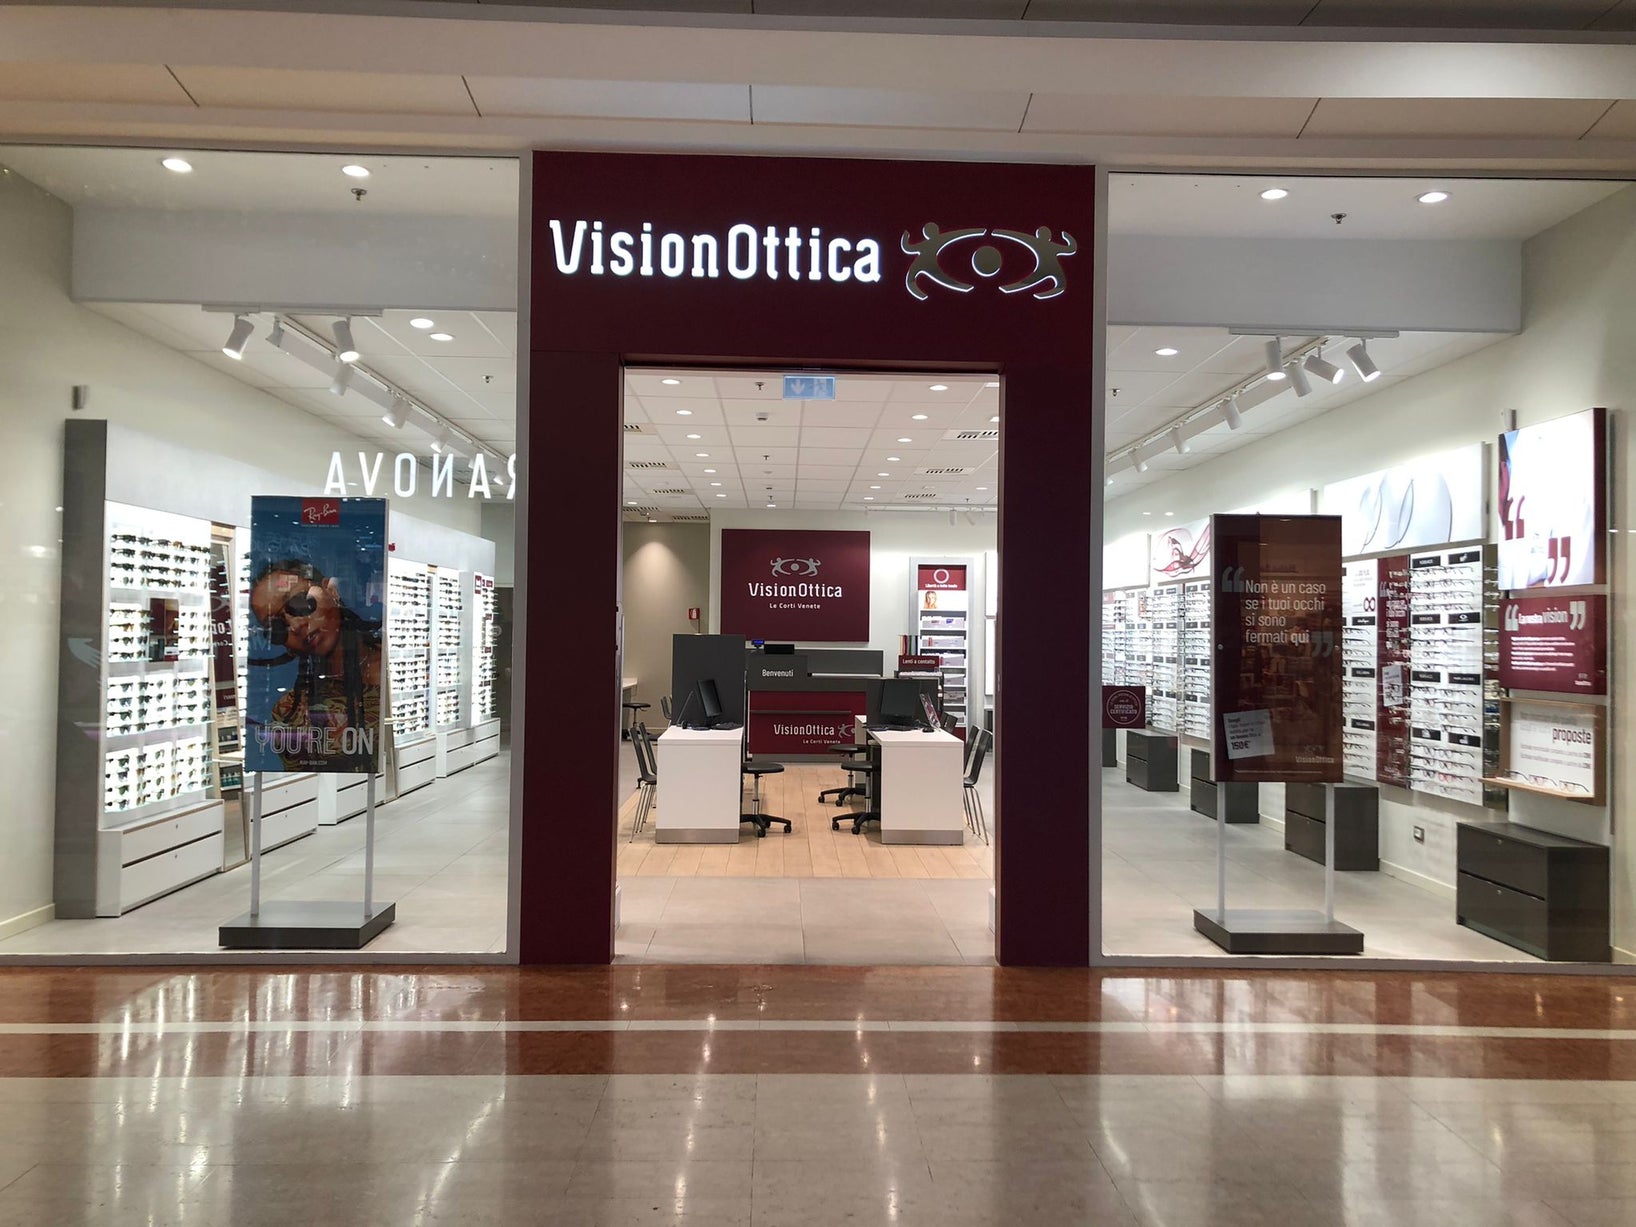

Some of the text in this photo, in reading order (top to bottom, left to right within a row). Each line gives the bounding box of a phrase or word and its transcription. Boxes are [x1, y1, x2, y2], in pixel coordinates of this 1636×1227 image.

[549, 219, 882, 283] VisionOttica
[748, 582, 842, 598] VisionOttica
[1245, 580, 1326, 594] Non è un caso
[1245, 596, 1325, 611] se i tuoi occhi
[1245, 612, 1286, 627] si sono
[1543, 607, 1568, 623] vision
[1245, 629, 1310, 646] fermati qui
[762, 669, 794, 677] Benvenuti
[773, 724, 835, 736] VisionOttica
[1552, 727, 1592, 745] proposte
[254, 725, 374, 755] YOU'RE ON
